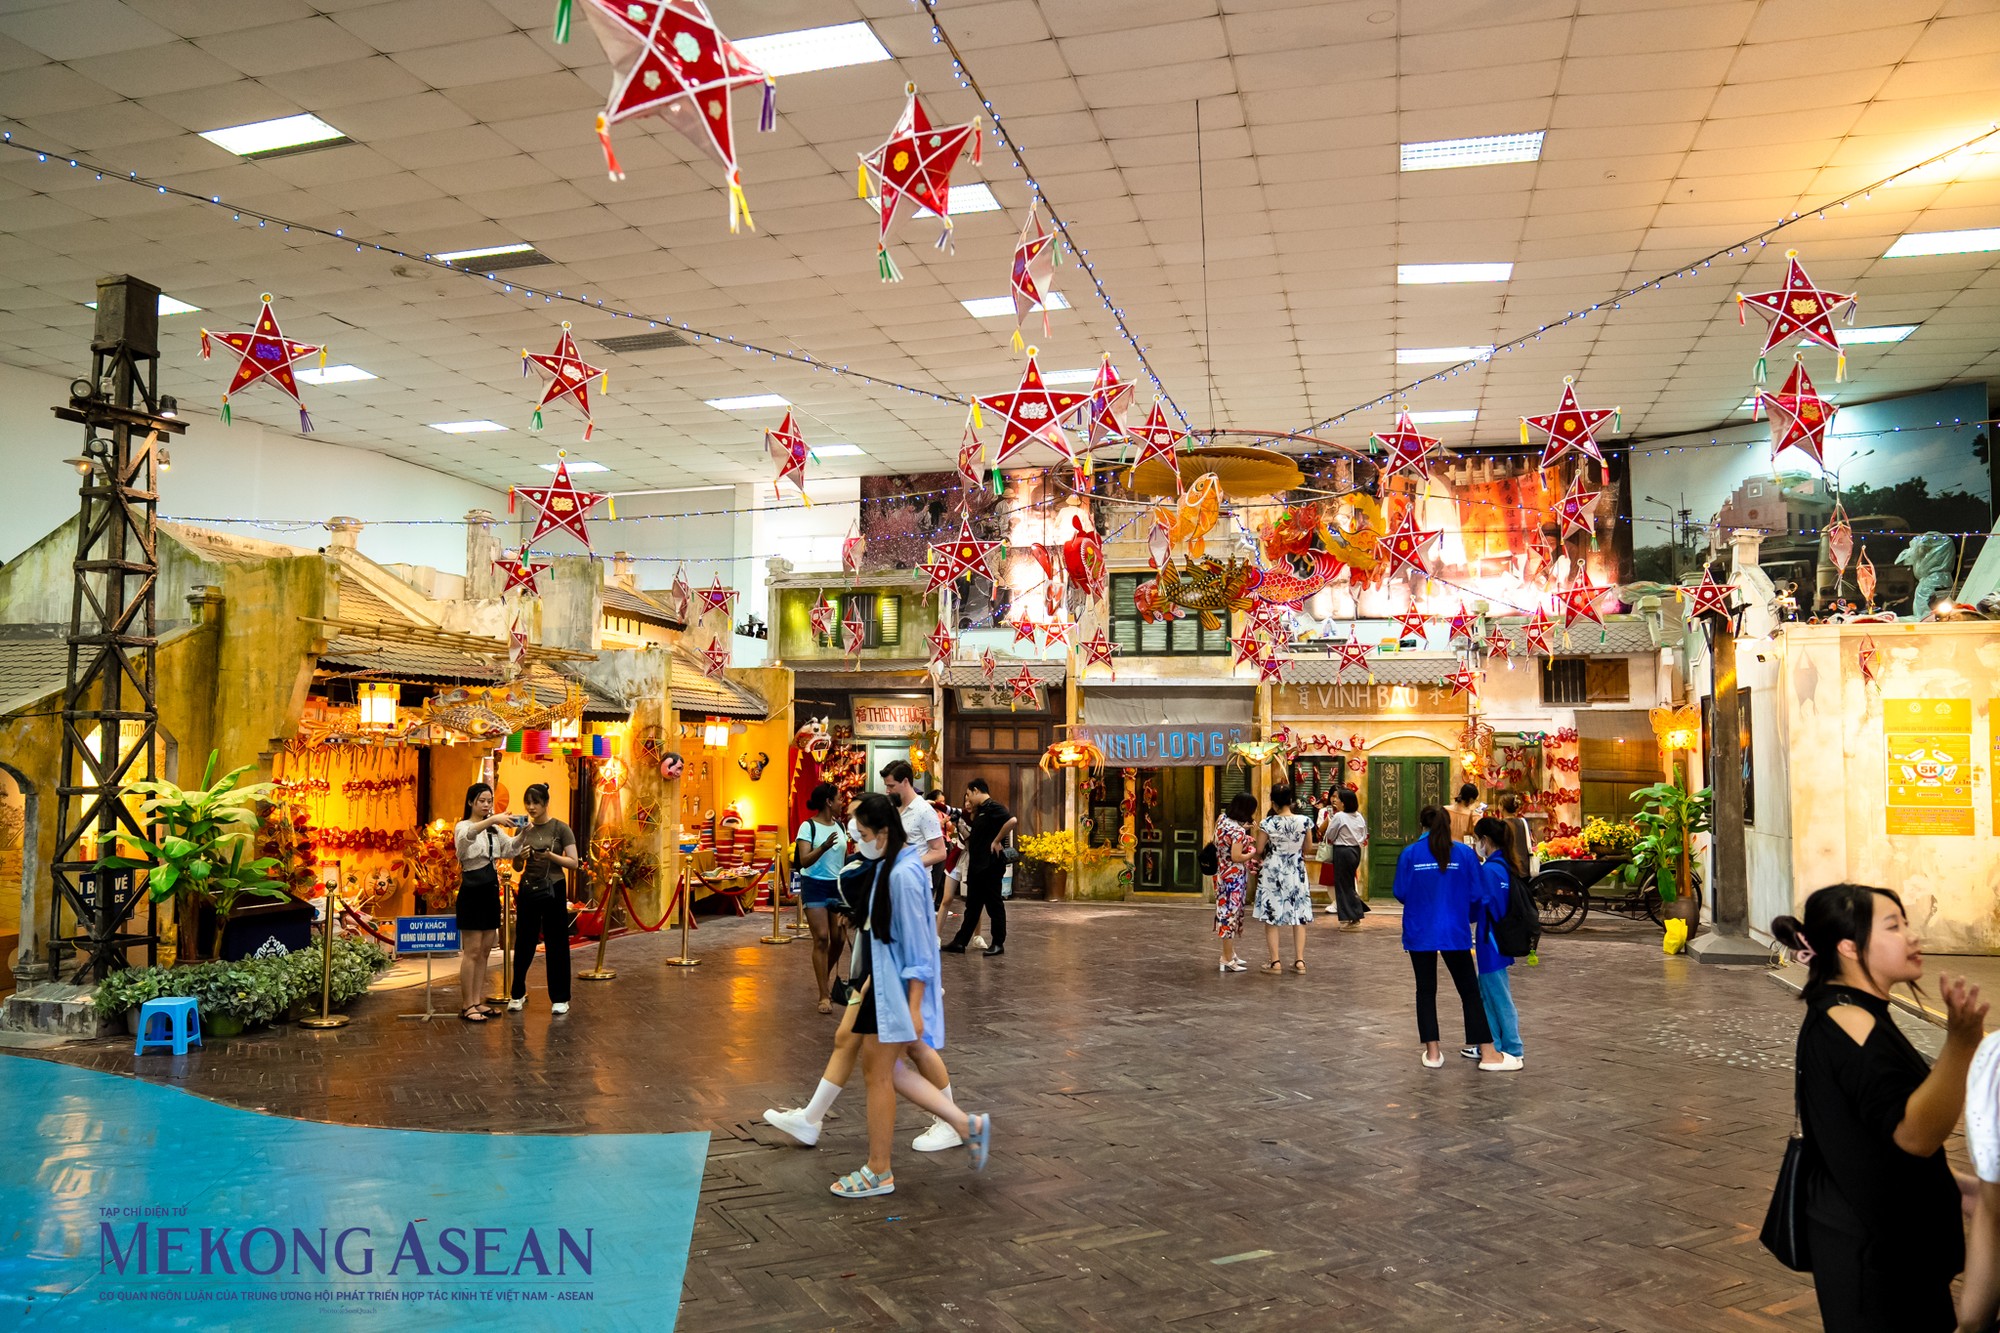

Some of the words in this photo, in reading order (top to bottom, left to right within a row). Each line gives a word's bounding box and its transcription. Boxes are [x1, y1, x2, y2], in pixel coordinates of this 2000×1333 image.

[1920, 766, 1937, 774] 5K
[114, 875, 128, 891] VÉ
[409, 921, 423, 930] QUÝ
[424, 920, 447, 930] KHÁCH
